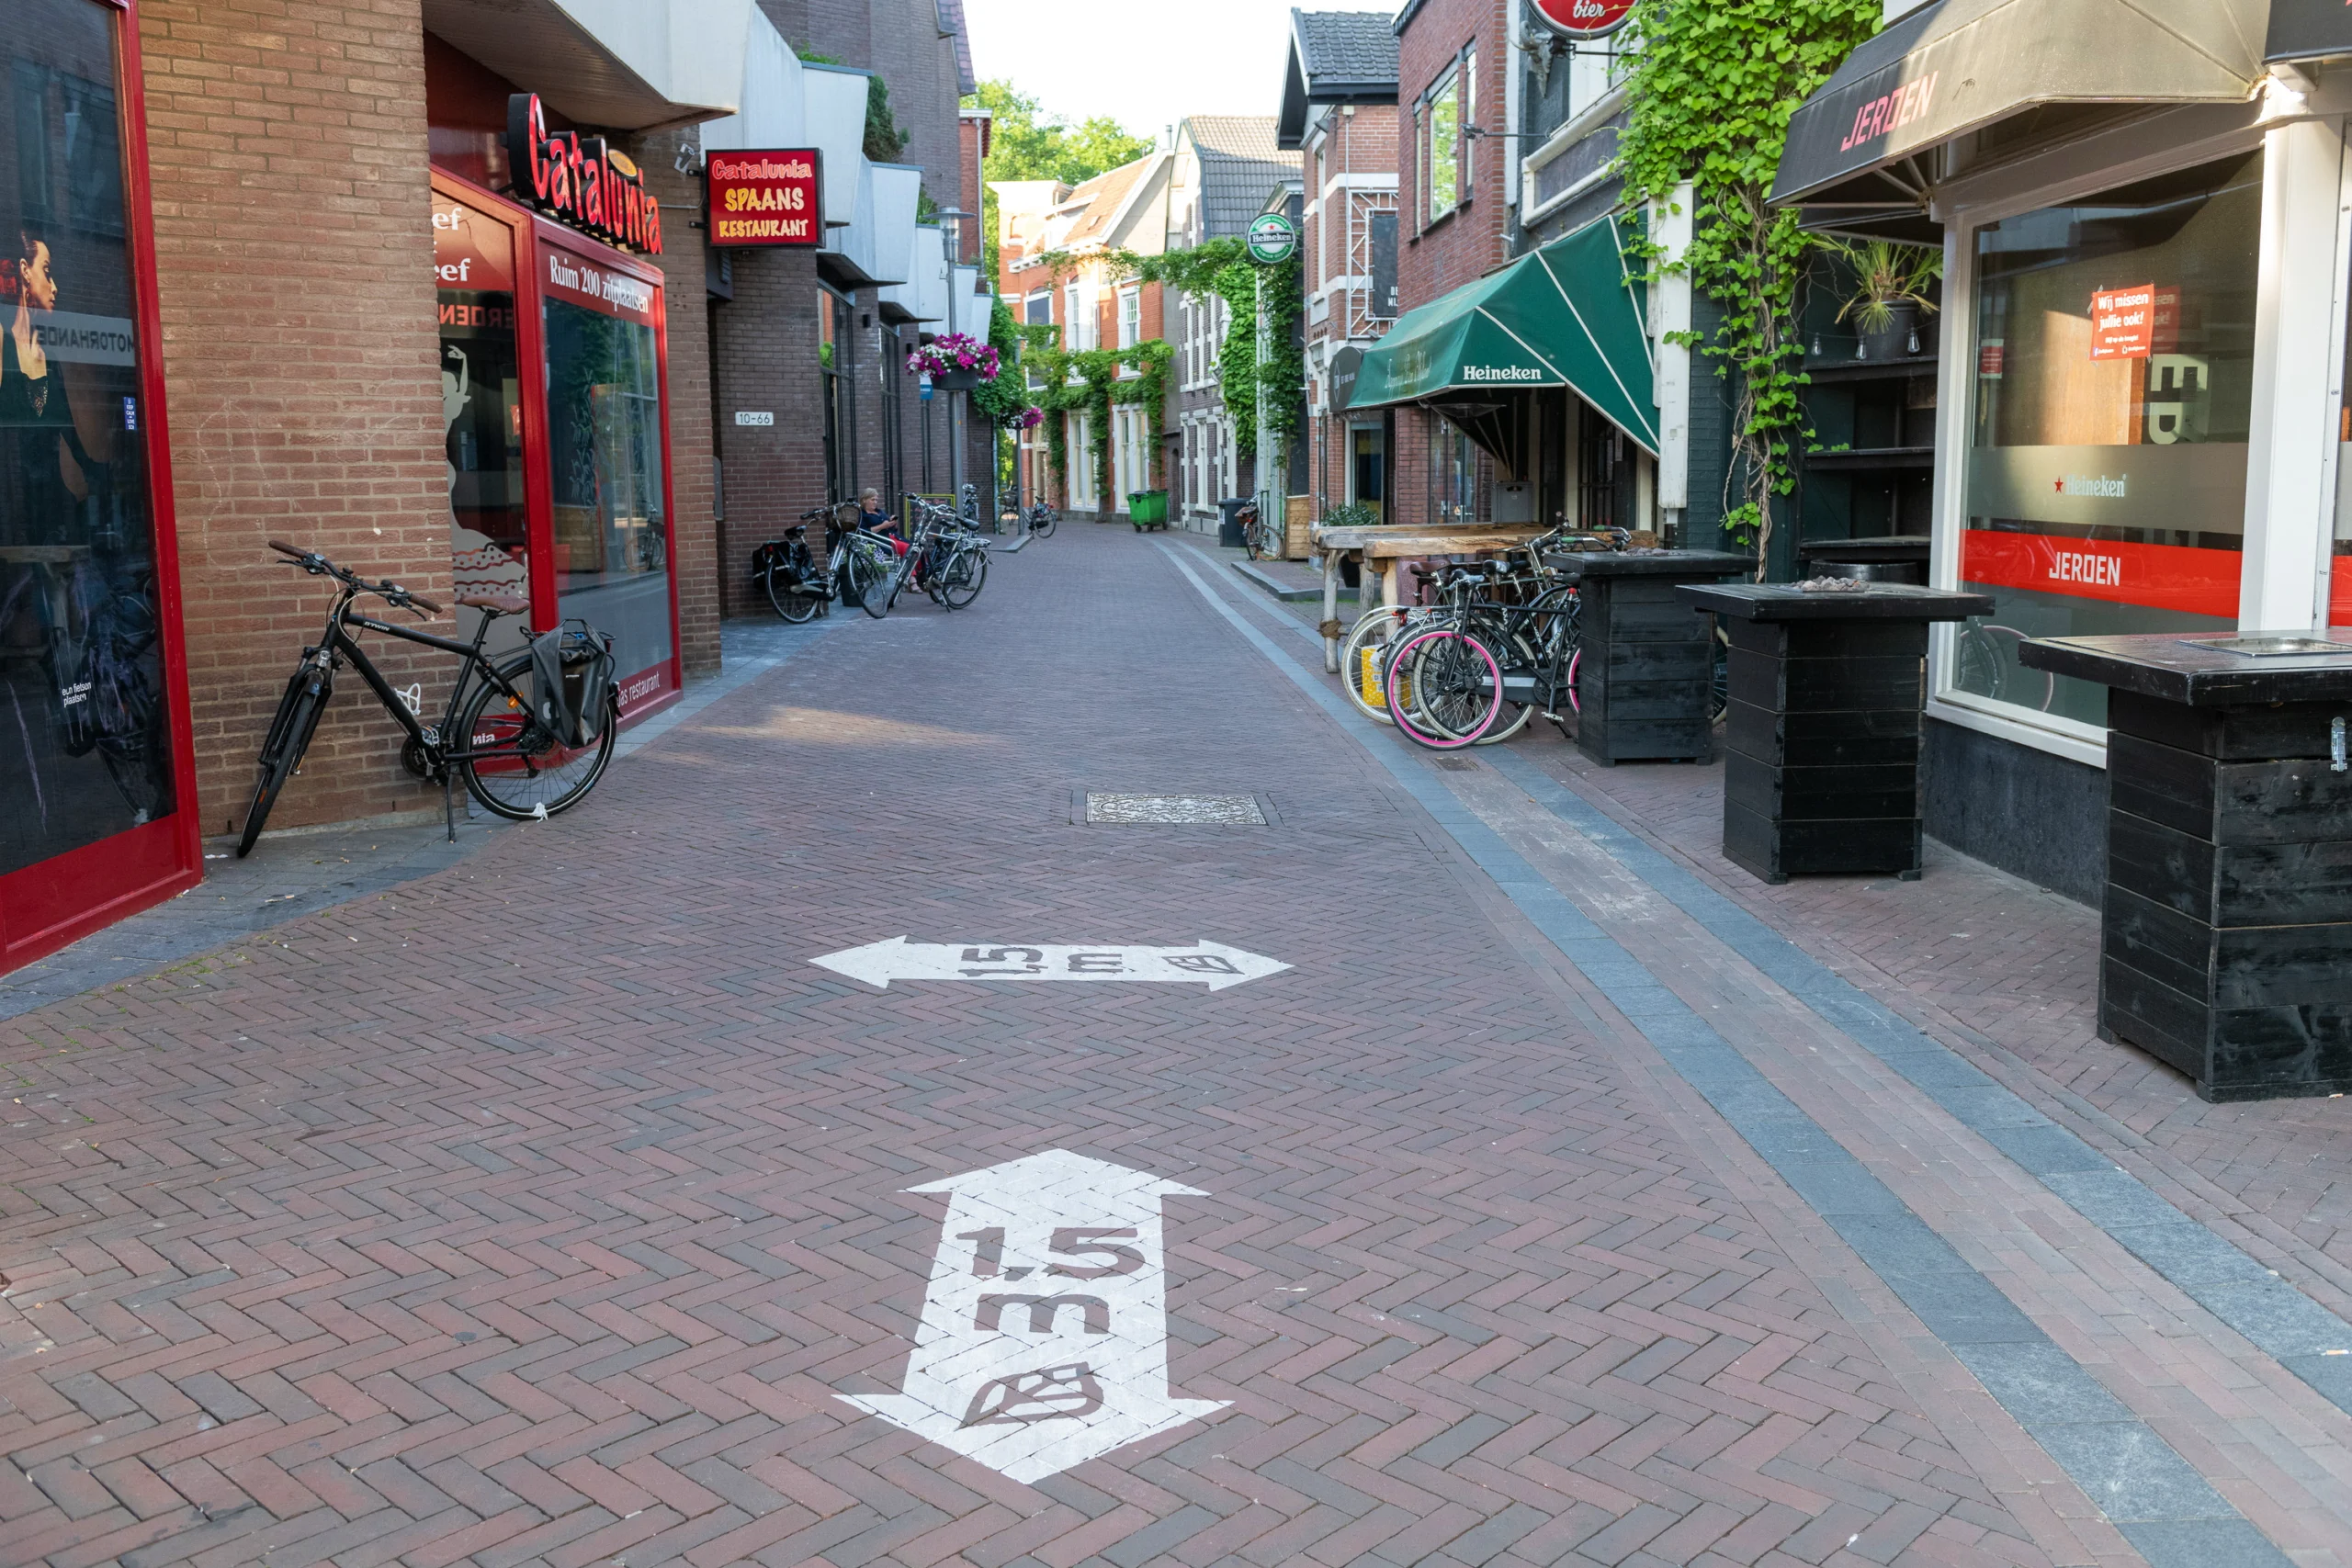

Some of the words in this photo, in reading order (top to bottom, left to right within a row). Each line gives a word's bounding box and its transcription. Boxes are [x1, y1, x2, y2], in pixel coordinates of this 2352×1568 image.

[1573, 0, 1606, 18] bier
[1840, 71, 1939, 152] JEROEN
[527, 93, 663, 255] Catalunia
[712, 159, 812, 180] Catalunia
[724, 186, 805, 212] SPAANS
[718, 219, 808, 237] RESTAURANT
[1251, 232, 1292, 243] Heineken
[550, 255, 579, 290] Ruim
[581, 266, 600, 297] 200
[602, 274, 649, 314] zitplaatsen
[2098, 295, 2113, 311] Wij
[2114, 293, 2149, 308] missen
[2098, 314, 2122, 333] jullie
[2123, 311, 2144, 326] ook!
[1463, 365, 1542, 380] Heineken
[740, 413, 770, 424] 10-66
[2065, 474, 2126, 497] Heineken
[2049, 551, 2121, 586] JEROEN
[629, 671, 660, 702] restaurant
[956, 1225, 1147, 1281] 1,5
[973, 1292, 1111, 1335] m
